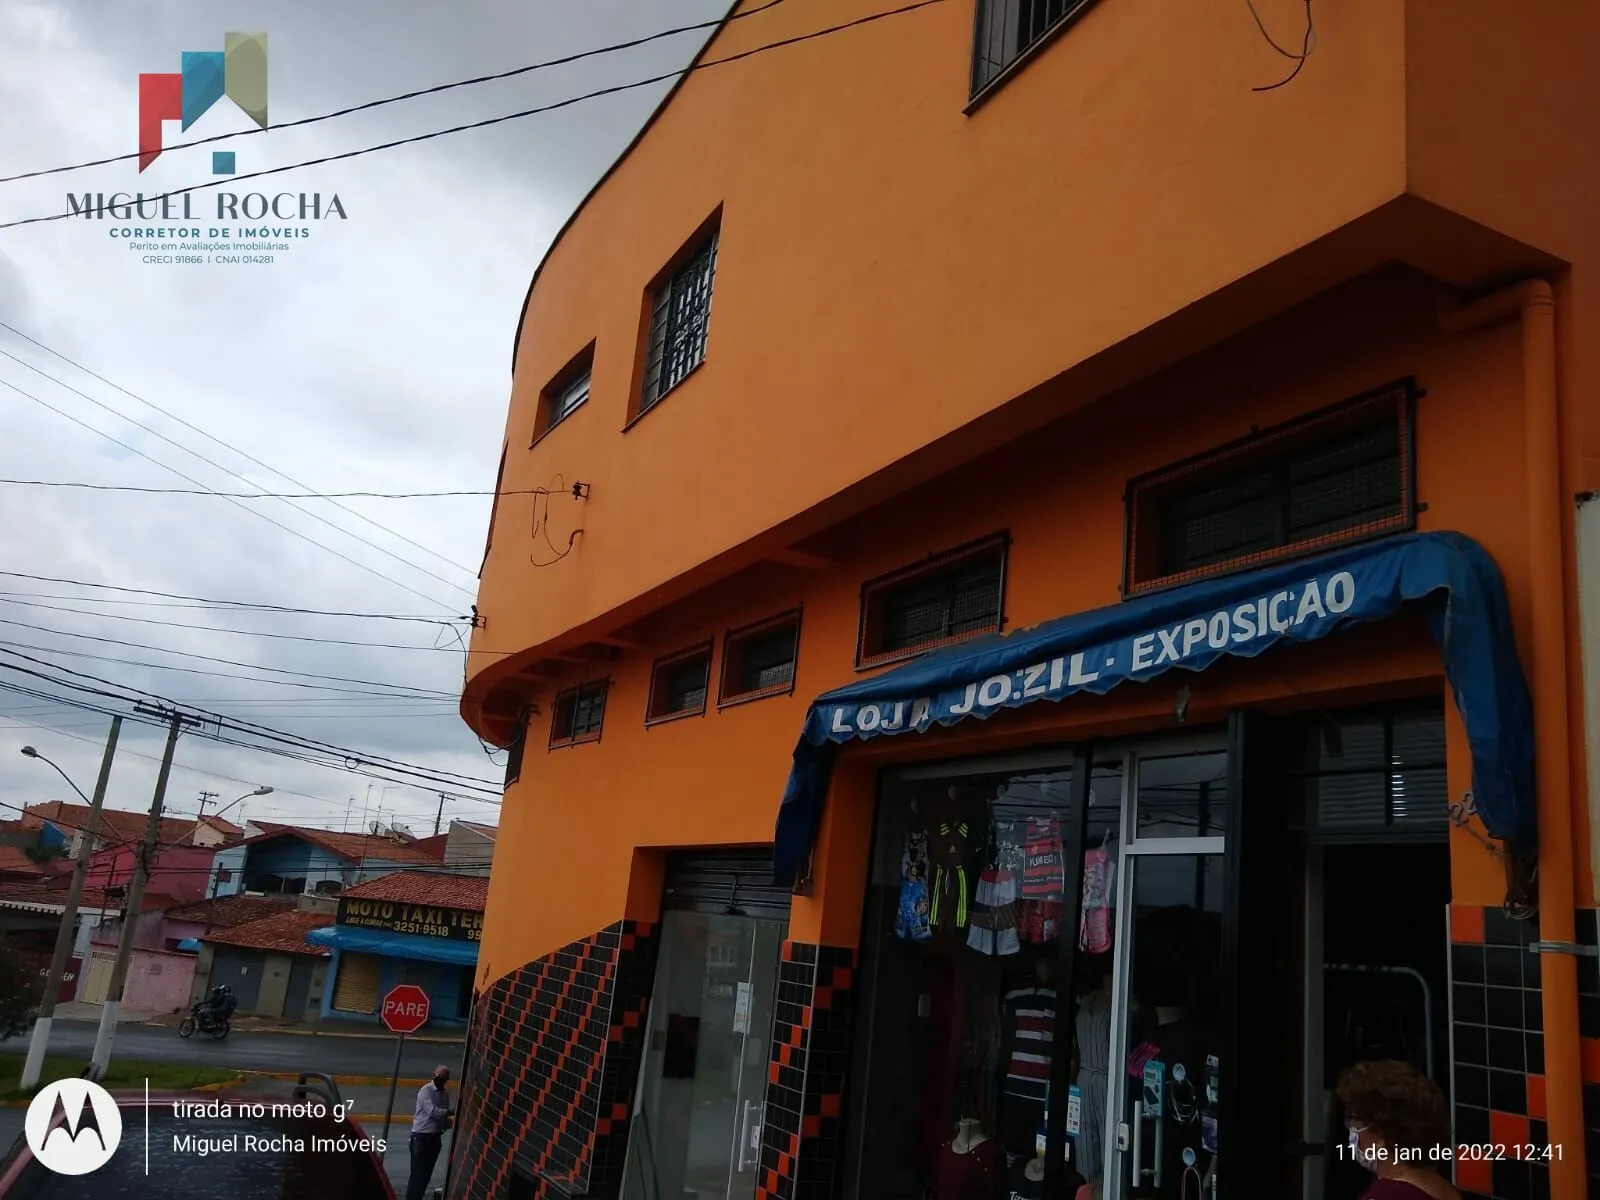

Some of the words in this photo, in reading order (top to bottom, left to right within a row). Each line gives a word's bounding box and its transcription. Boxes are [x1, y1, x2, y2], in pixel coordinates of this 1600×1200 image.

[832, 697, 930, 732] LOJA
[346, 901, 394, 919] MOTO
[402, 905, 443, 925] TAXI
[385, 1001, 426, 1017] PARE
